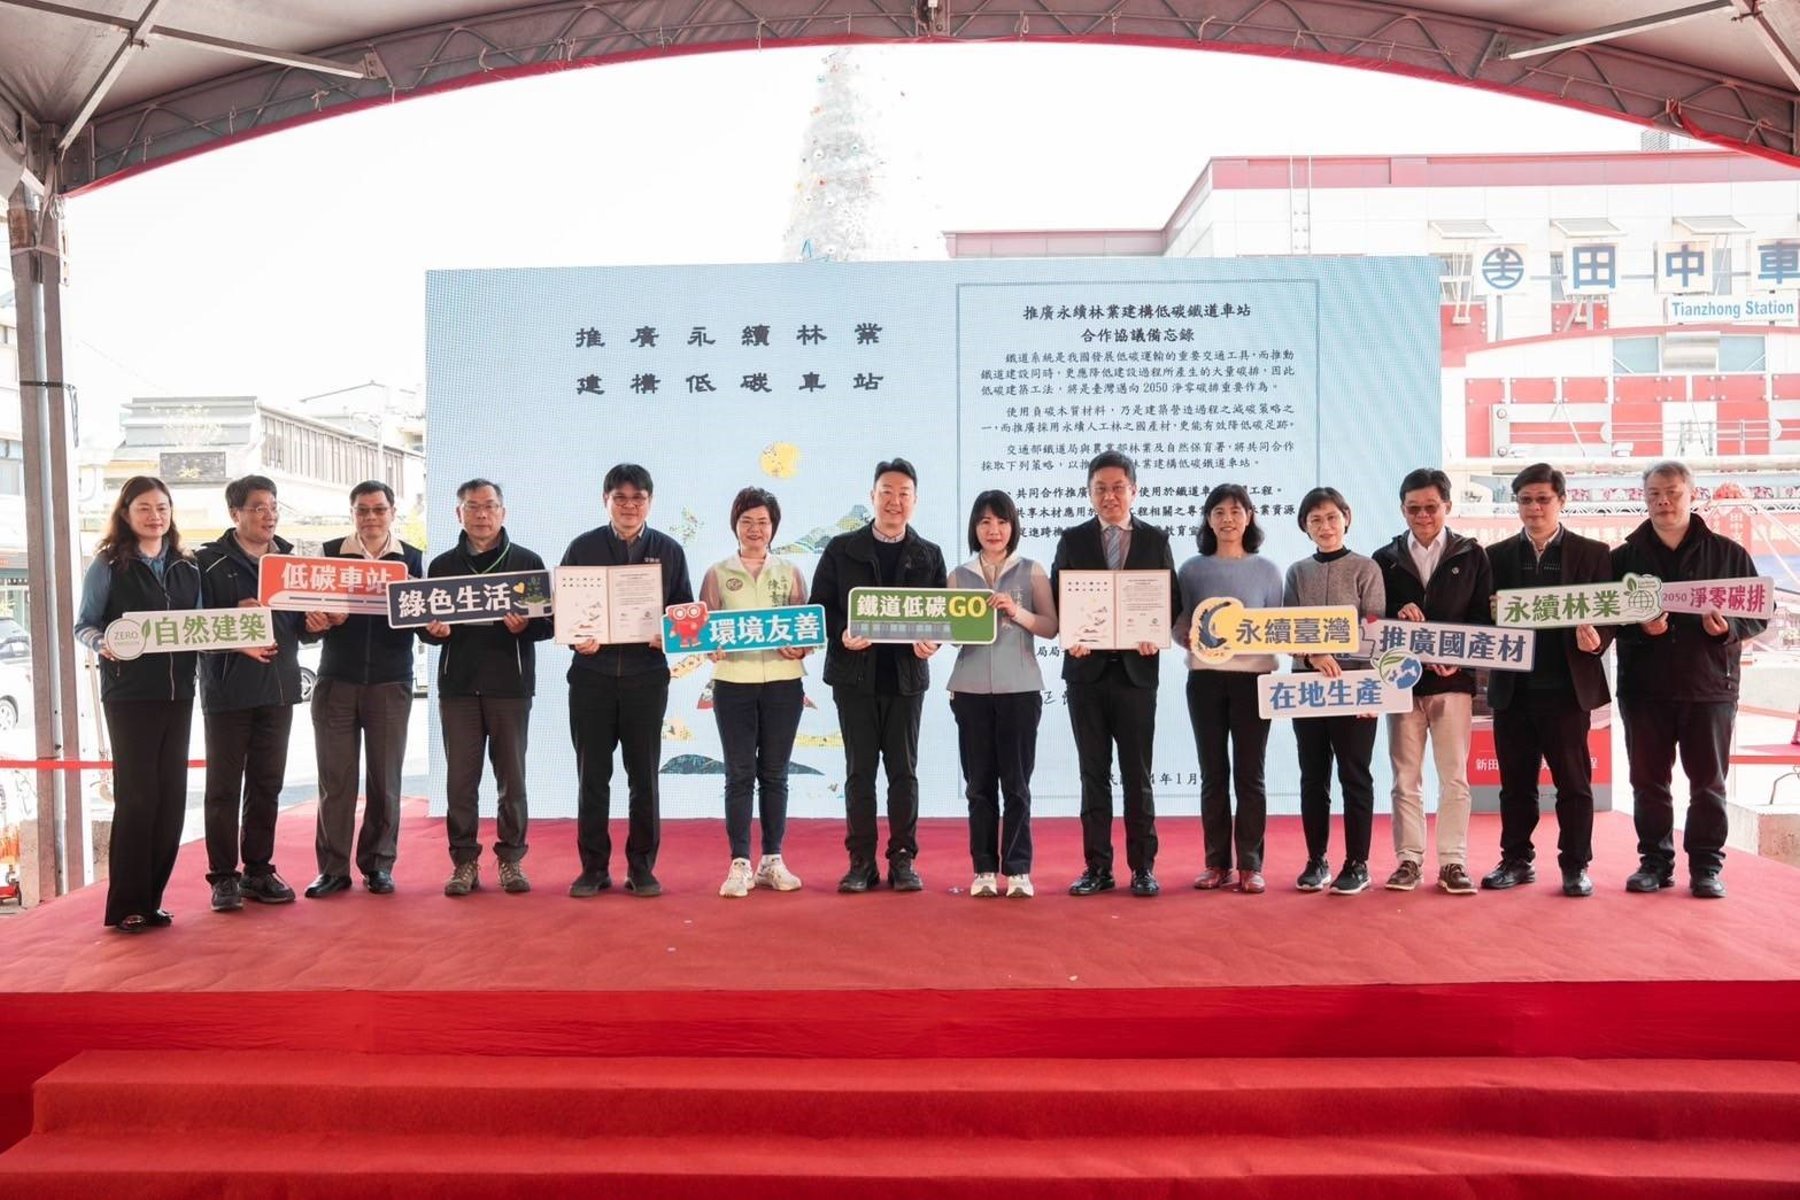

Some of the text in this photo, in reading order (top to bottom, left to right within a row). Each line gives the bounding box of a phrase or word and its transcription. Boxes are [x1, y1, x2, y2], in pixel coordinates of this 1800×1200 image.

[1023, 303, 1252, 320] 推廣永續林業建構低碳鐵道車站
[1672, 300, 1795, 319] Tianzhong Station
[575, 323, 883, 349] 推廣永續林業
[1080, 328, 1196, 343] 合作協議備忘錄
[576, 372, 884, 395] 建構低碳車站
[1143, 382, 1168, 393] 2050
[281, 562, 393, 593] 低碳車站
[397, 582, 512, 618] 綠色生活
[857, 594, 988, 618] 鐵道低碳GO
[1504, 589, 1621, 623] 永續林業
[1662, 584, 1766, 613] 2050 淨零碳排
[114, 631, 139, 640] ZERO
[154, 613, 267, 646] 自然建築
[708, 612, 821, 645] 環境友善
[1236, 617, 1350, 644] 永續臺灣
[1379, 625, 1527, 663] 推廣國產材
[1269, 678, 1383, 710] 在地生產
